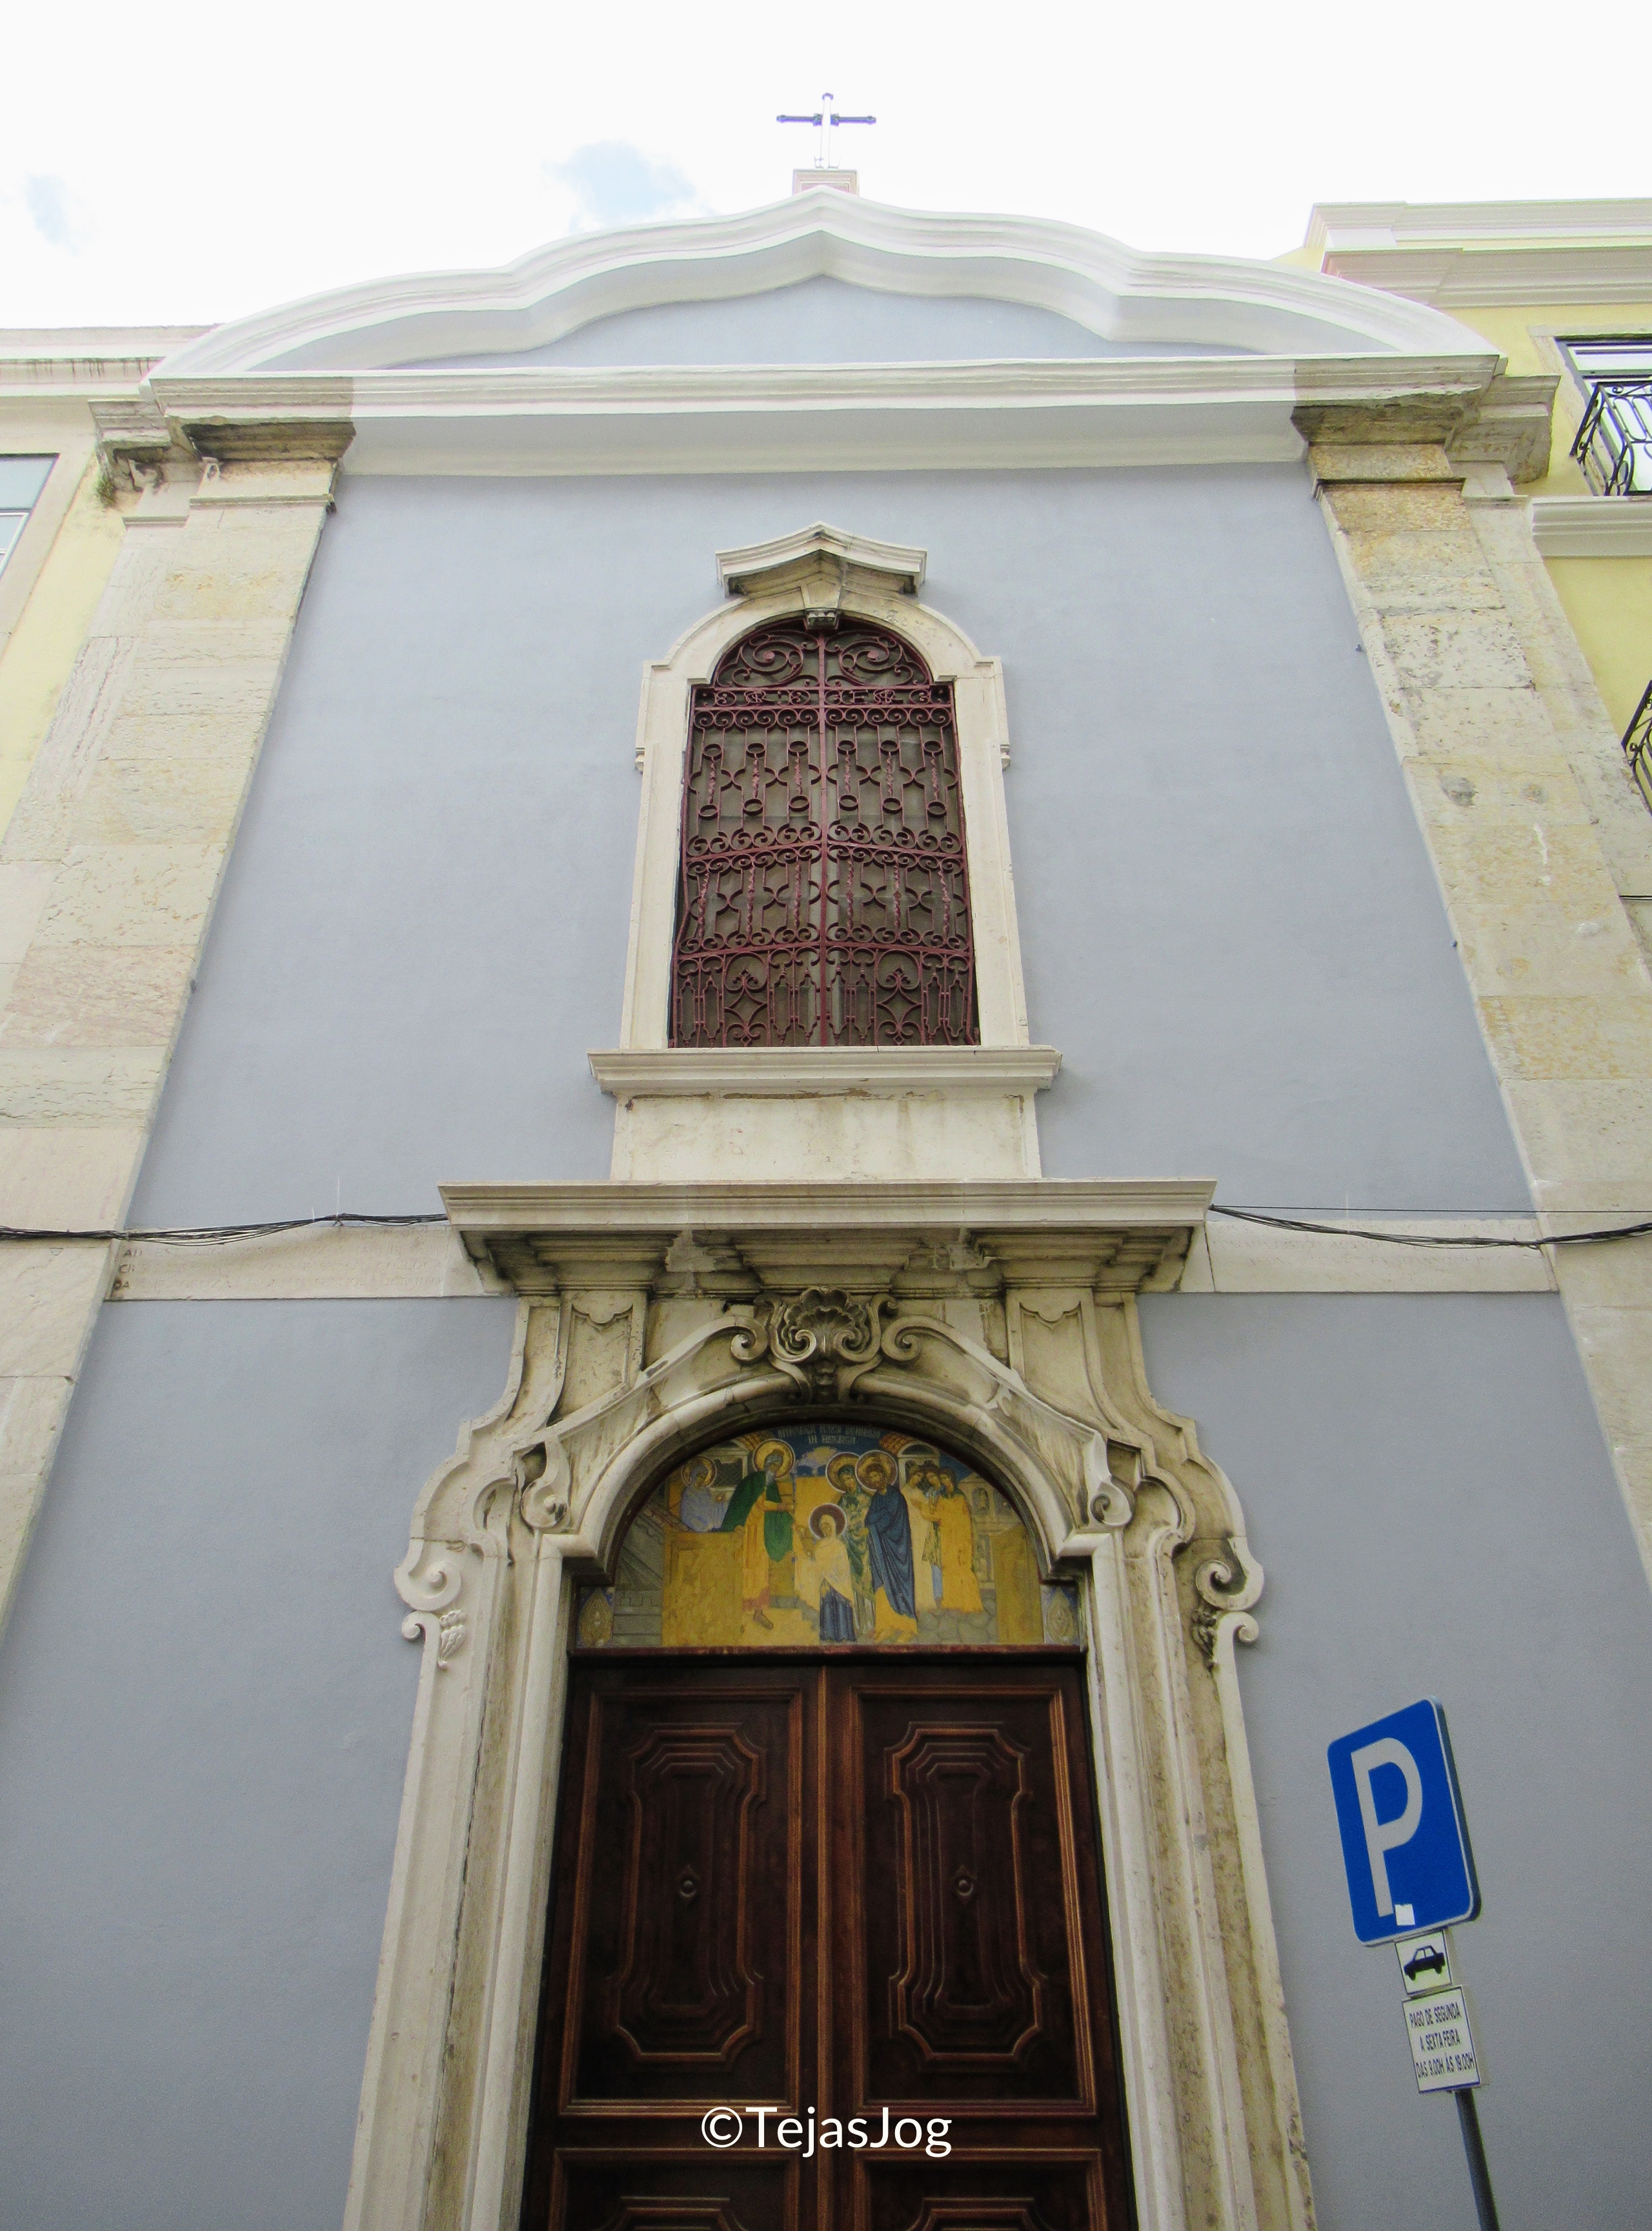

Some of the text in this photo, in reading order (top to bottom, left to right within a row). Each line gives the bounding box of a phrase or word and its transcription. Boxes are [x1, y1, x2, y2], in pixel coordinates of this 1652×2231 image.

[1351, 1737, 1423, 1917] P
[1410, 2002, 1460, 2028] PAGO DE SEGUNDA
[1416, 2061, 1428, 2079] DAS
